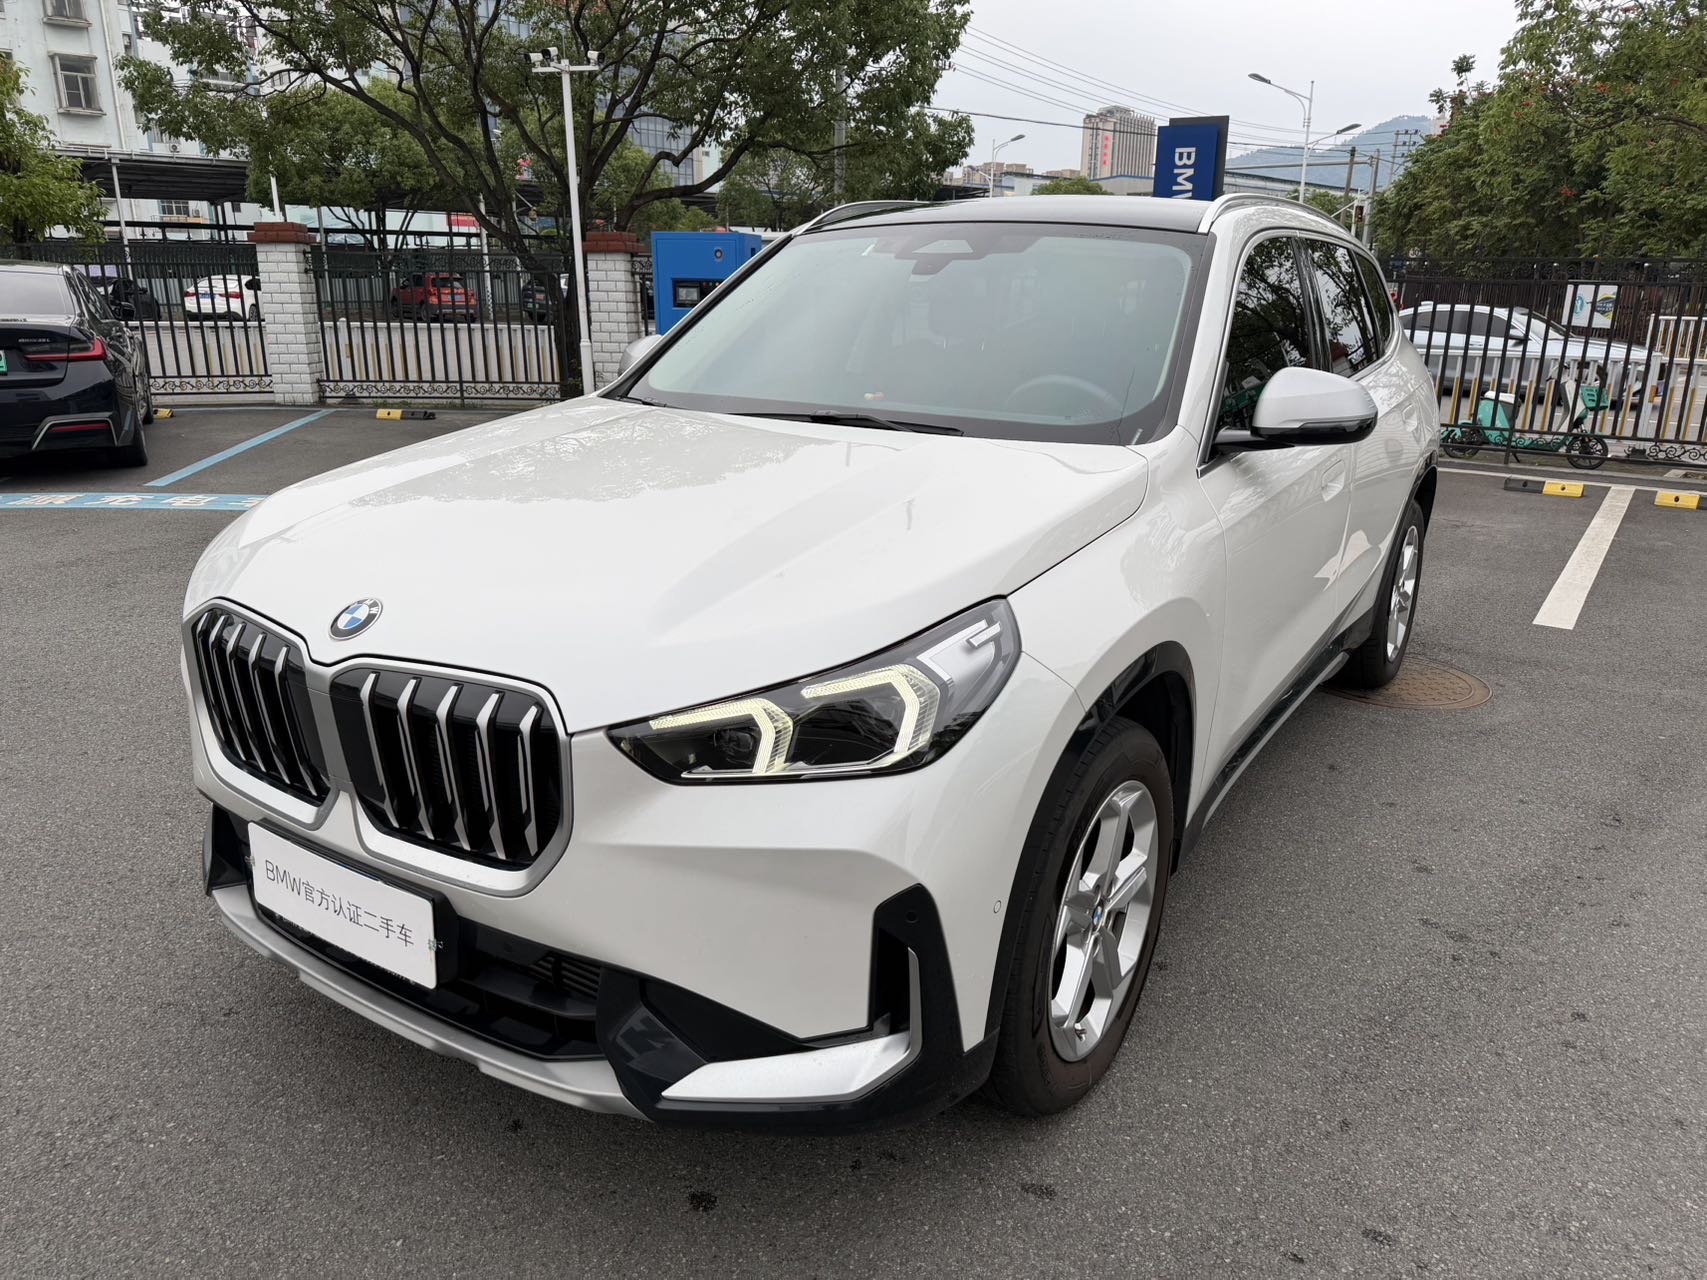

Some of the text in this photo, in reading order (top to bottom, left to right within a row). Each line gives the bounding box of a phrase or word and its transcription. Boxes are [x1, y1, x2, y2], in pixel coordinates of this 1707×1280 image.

[1172, 147, 1196, 199] BM
[265, 859, 414, 947] BMW官方认证二手车
